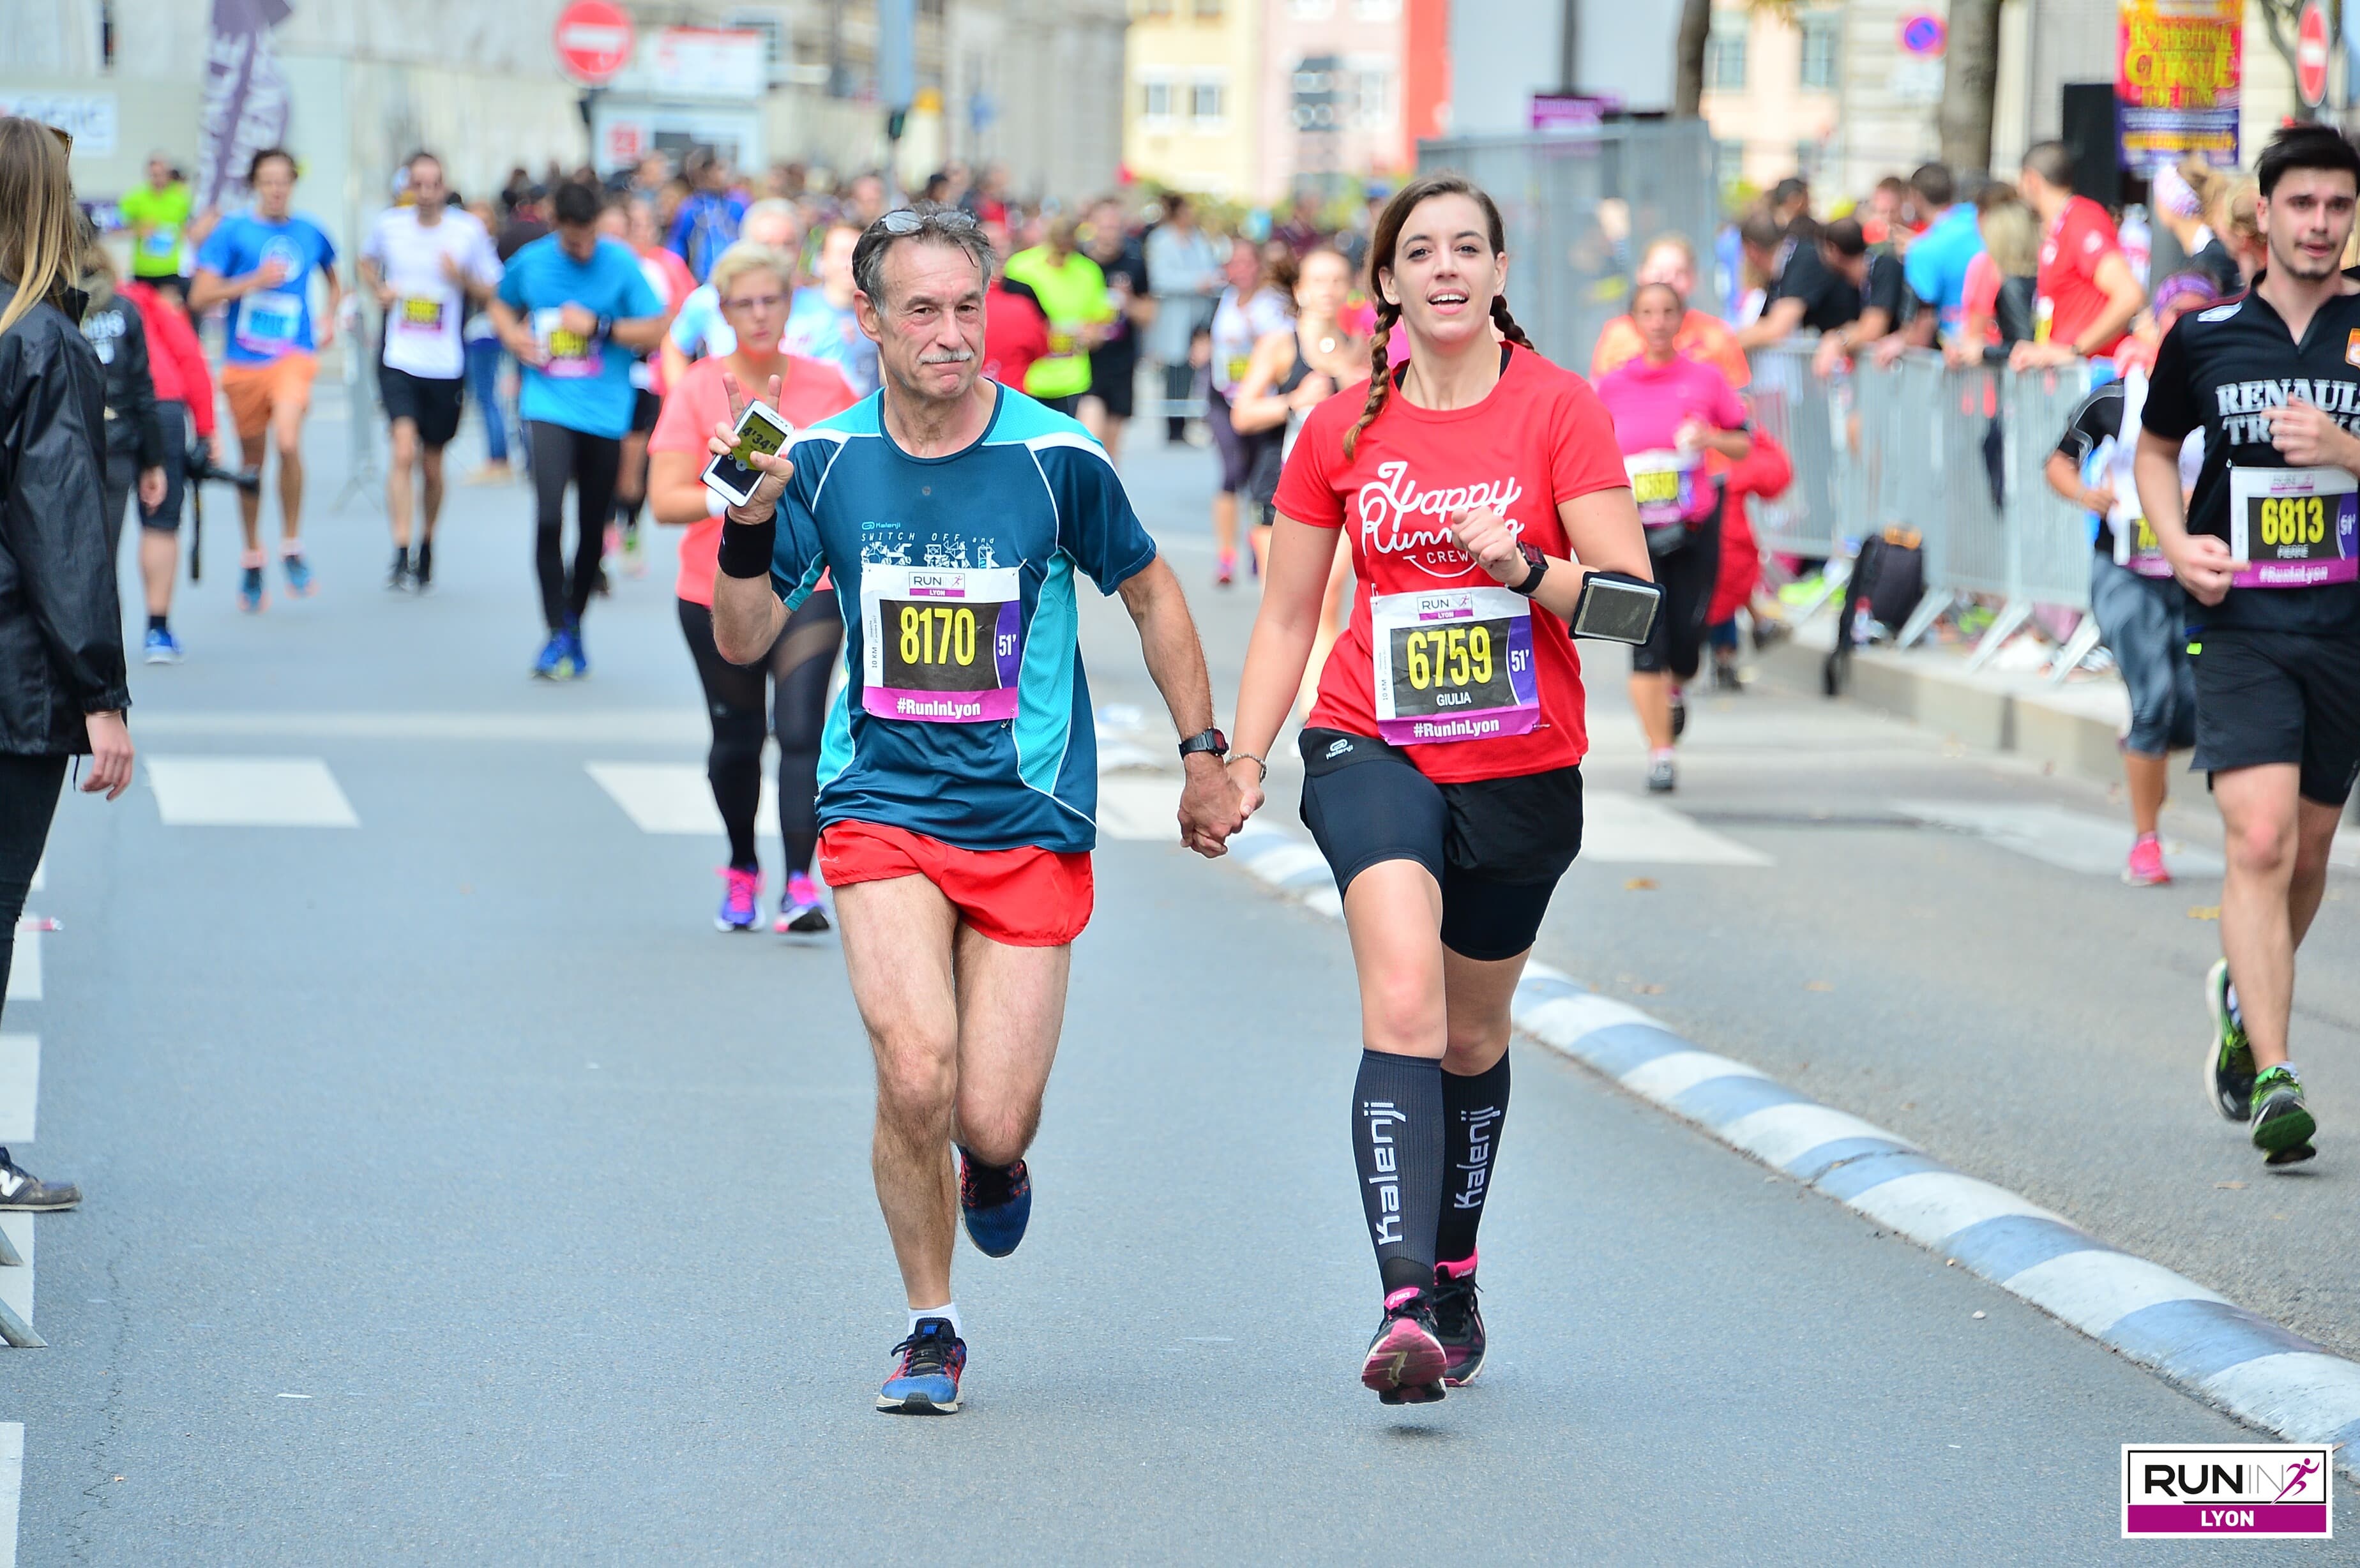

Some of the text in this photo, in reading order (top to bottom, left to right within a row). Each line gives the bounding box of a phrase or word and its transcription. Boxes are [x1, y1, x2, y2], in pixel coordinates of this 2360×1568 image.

[2215, 378, 2360, 416] RENAUL
[1359, 461, 1522, 532] Happy
[2261, 495, 2325, 545] 6813
[861, 531, 916, 542] SWITCH
[931, 532, 960, 542] OFF
[1438, 611, 1455, 619] LYON
[900, 606, 975, 666] 8170
[872, 646, 878, 659] KM
[1407, 626, 1493, 690] 6759
[896, 698, 981, 720] #RunInLyon
[1436, 692, 1472, 707] GIULIA
[1413, 719, 1500, 739] #RunInLyon
